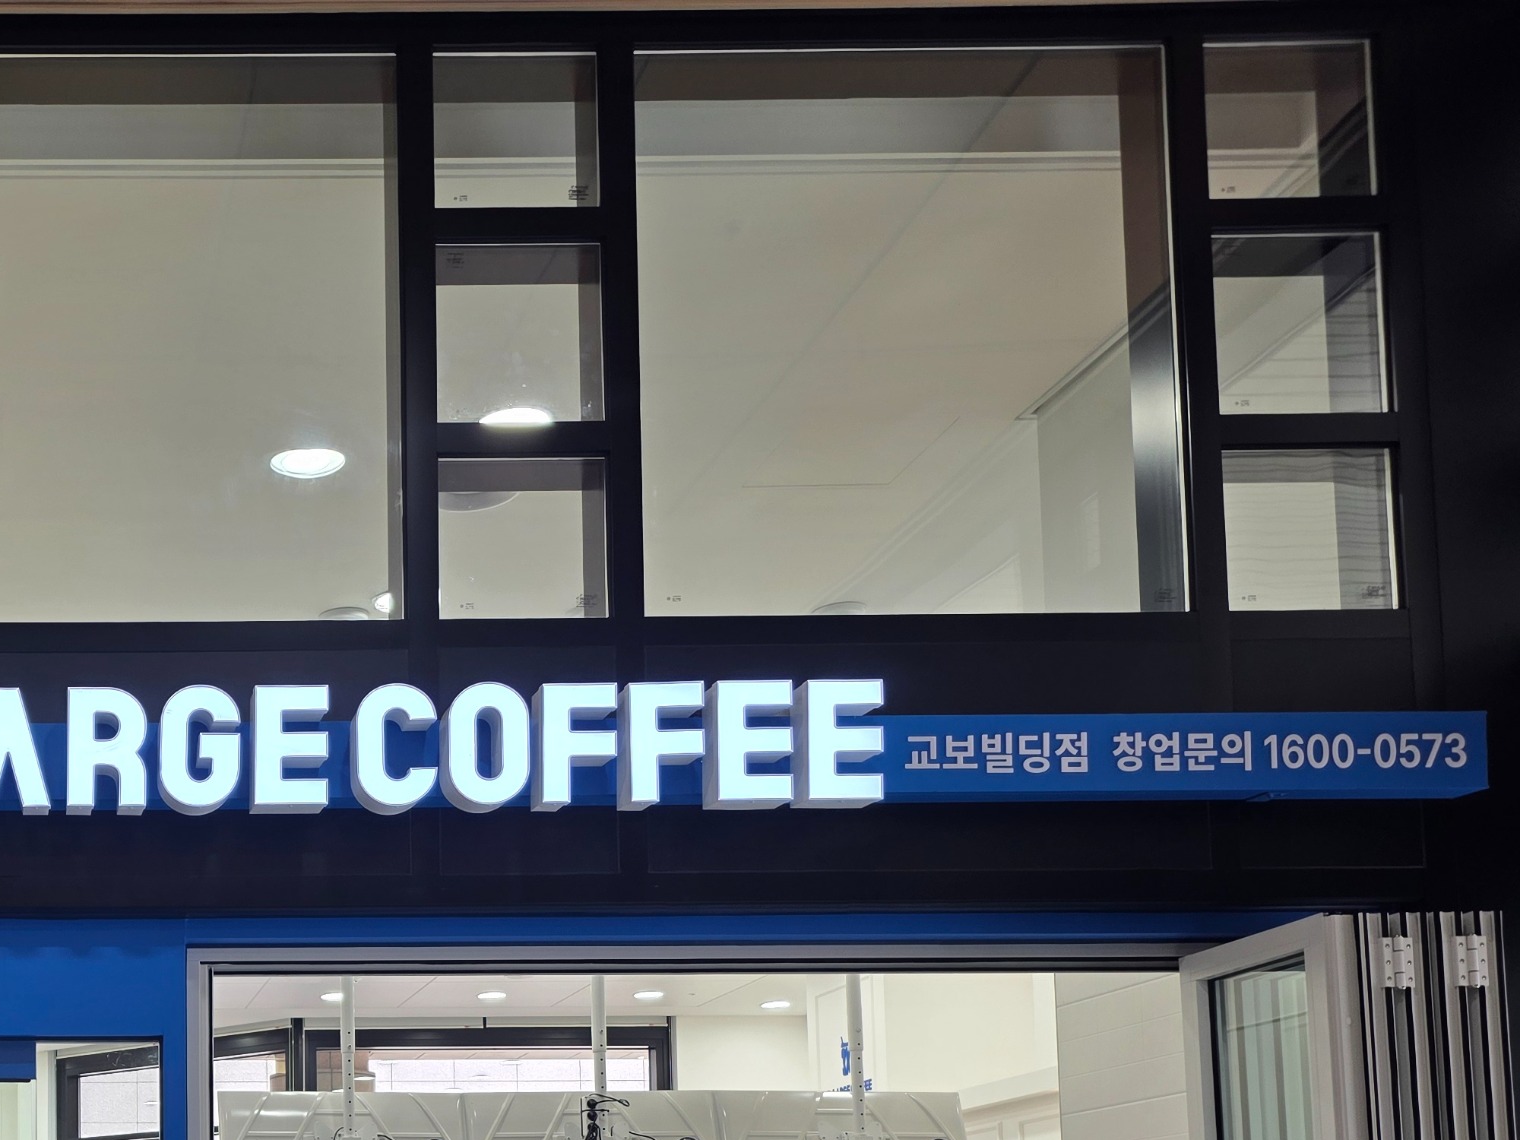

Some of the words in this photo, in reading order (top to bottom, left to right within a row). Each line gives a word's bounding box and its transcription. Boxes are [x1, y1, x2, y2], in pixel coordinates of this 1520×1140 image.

[351, 679, 885, 813] COFFEE
[904, 731, 1090, 776] 교보빌딩점
[1112, 729, 1253, 773] 창업문의
[1264, 730, 1469, 770] 1600-0573
